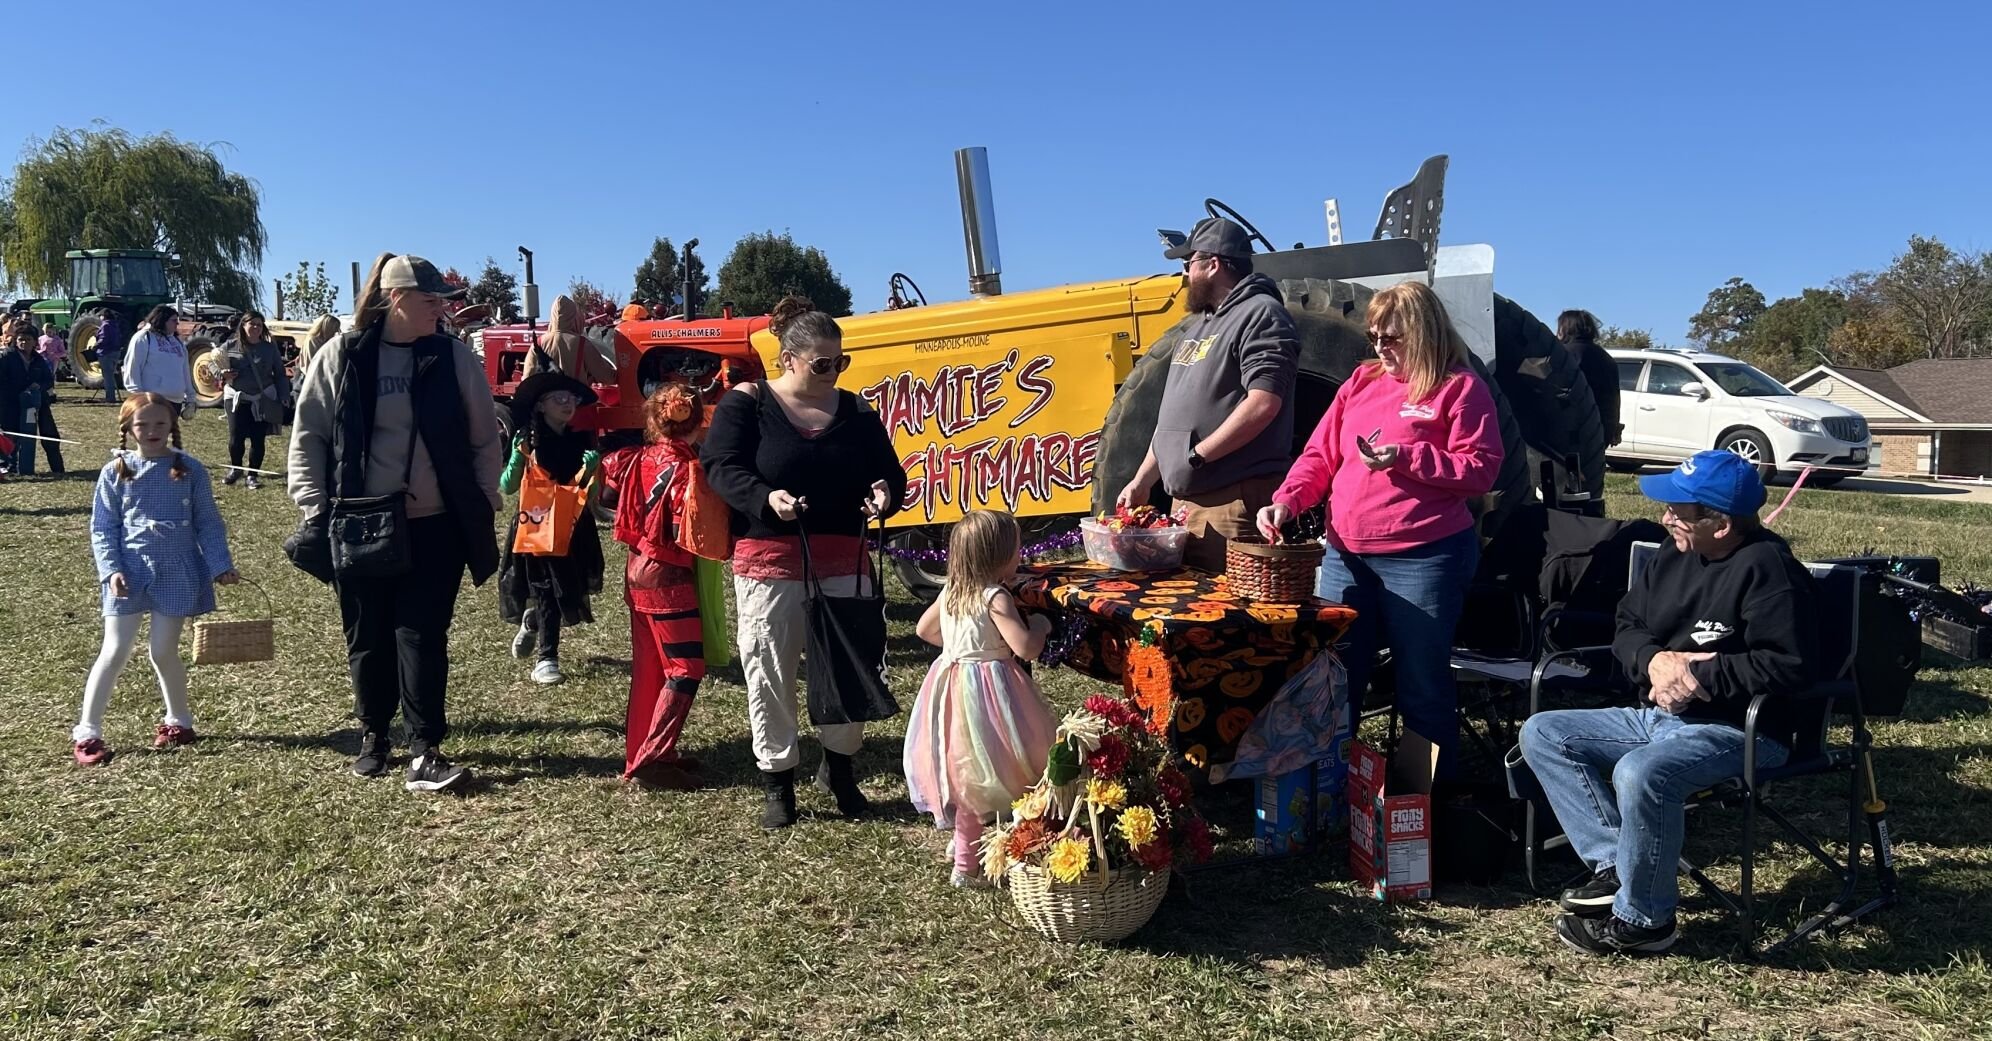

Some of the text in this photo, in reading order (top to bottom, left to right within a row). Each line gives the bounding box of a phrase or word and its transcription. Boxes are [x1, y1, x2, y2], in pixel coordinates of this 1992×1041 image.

[652, 328, 721, 339] ALLIS-CHALMERS
[914, 334, 990, 354] MINNEAPOLIS-MOLINE
[860, 348, 1056, 446] JAMIE'S
[899, 429, 1102, 522] GHTMARE
